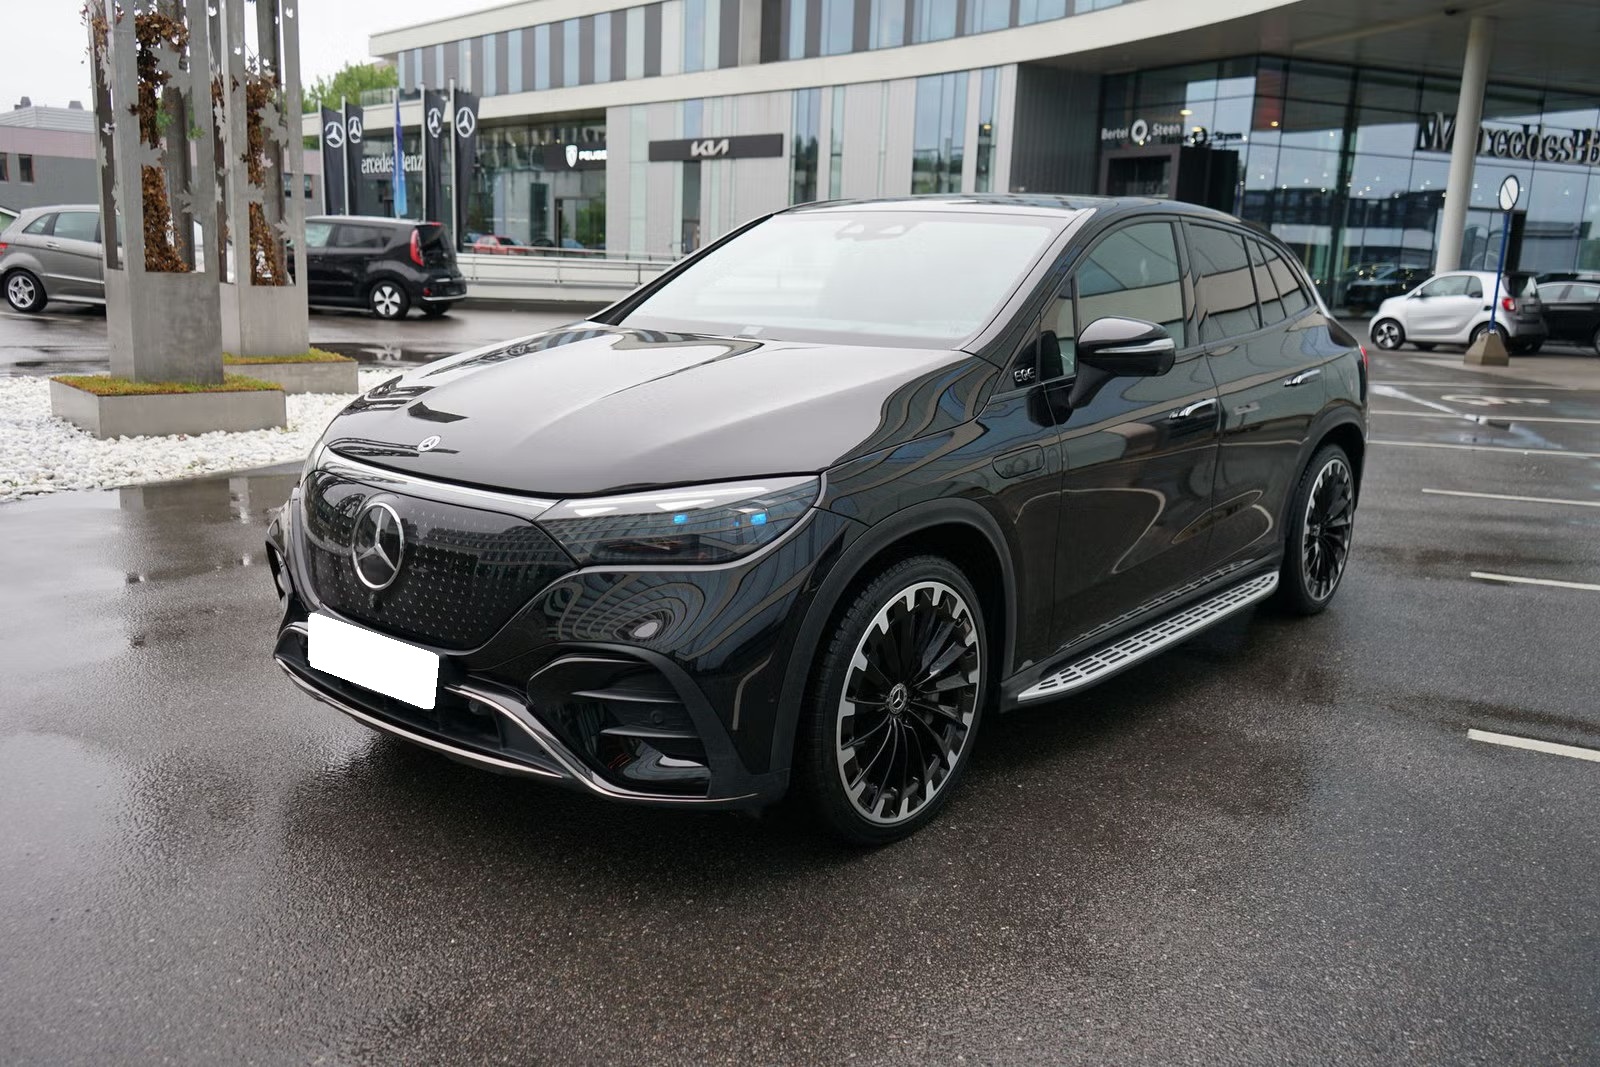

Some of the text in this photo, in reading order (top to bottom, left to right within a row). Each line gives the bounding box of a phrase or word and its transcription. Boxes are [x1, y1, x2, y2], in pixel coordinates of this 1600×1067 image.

[1101, 127, 1129, 141] Bertel
[1152, 123, 1181, 136] Steen
[691, 138, 729, 157] KIA
